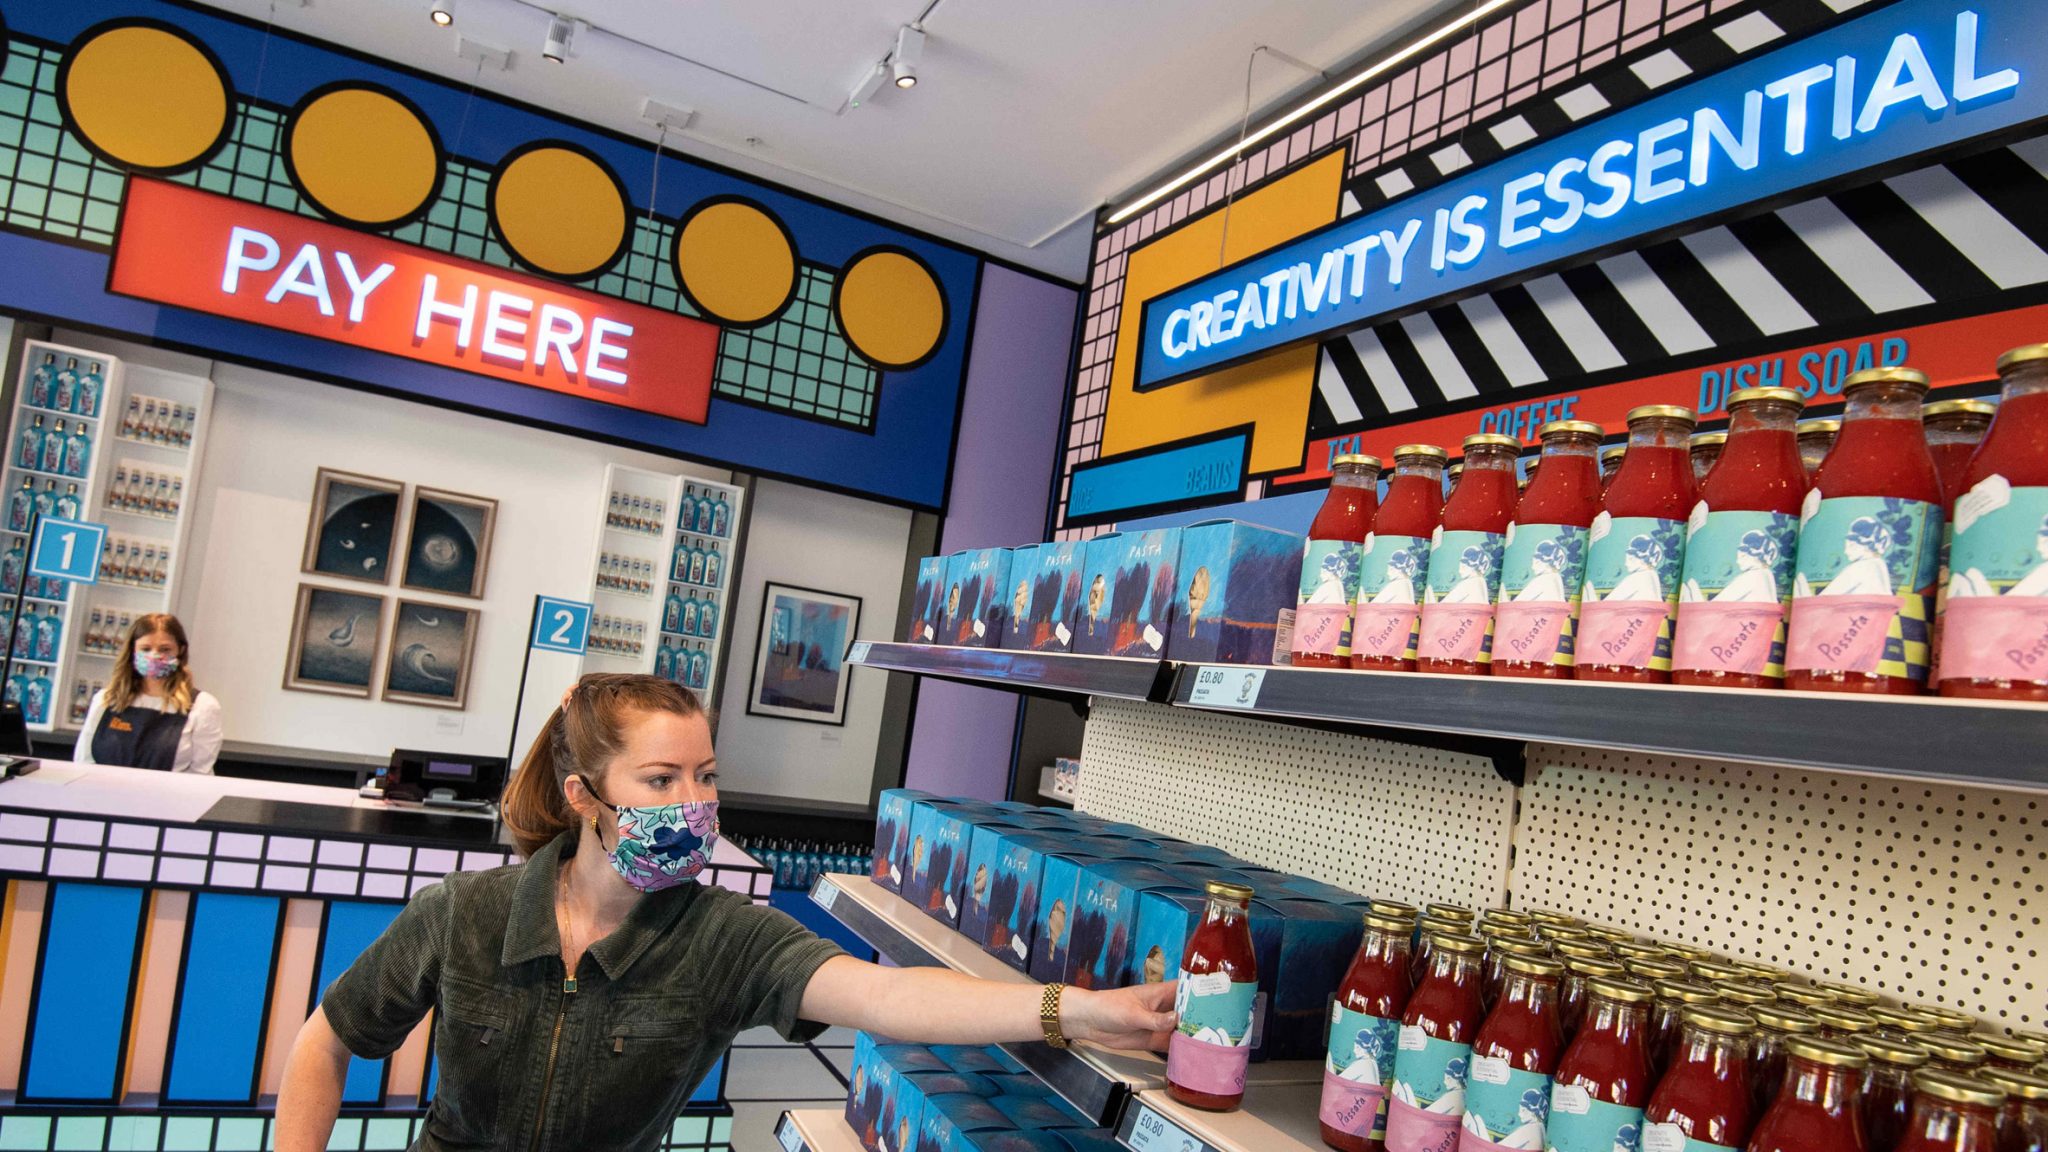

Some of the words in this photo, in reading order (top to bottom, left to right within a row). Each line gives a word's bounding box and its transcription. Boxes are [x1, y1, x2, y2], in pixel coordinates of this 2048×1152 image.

[1161, 219, 1422, 359] CREATIVITY
[1430, 196, 1488, 271] IS
[1499, 10, 2019, 249] ESSENTIAL
[221, 226, 395, 323] PAY
[415, 274, 634, 386] HERE
[1698, 359, 1784, 414] DISH
[1797, 338, 1908, 397] SOAP
[1479, 396, 1580, 441] COFFEE
[1327, 436, 1361, 472] TEA
[1185, 461, 1234, 493] BEANS
[61, 532, 76, 570] 1
[970, 560, 990, 572] PASTA
[1045, 554, 1072, 567] PASTA
[1129, 543, 1162, 558] PASTA
[550, 610, 575, 645] 2
[1303, 616, 1332, 648] Passata
[1368, 616, 1401, 650] Passata
[1438, 618, 1474, 653] Passata
[1510, 617, 1548, 654] Passata
[1601, 618, 1643, 657] Passata
[1710, 621, 1758, 664] Passata
[1817, 615, 1869, 662] Passata
[1199, 671, 1224, 685] £0.80
[939, 827, 960, 841] PASTA
[1003, 854, 1028, 873] PASTA
[1087, 889, 1118, 912] PASTA
[1140, 1113, 1164, 1137] £0.80
[1336, 1096, 1366, 1127] Passata
[929, 1118, 950, 1144] PASTA
